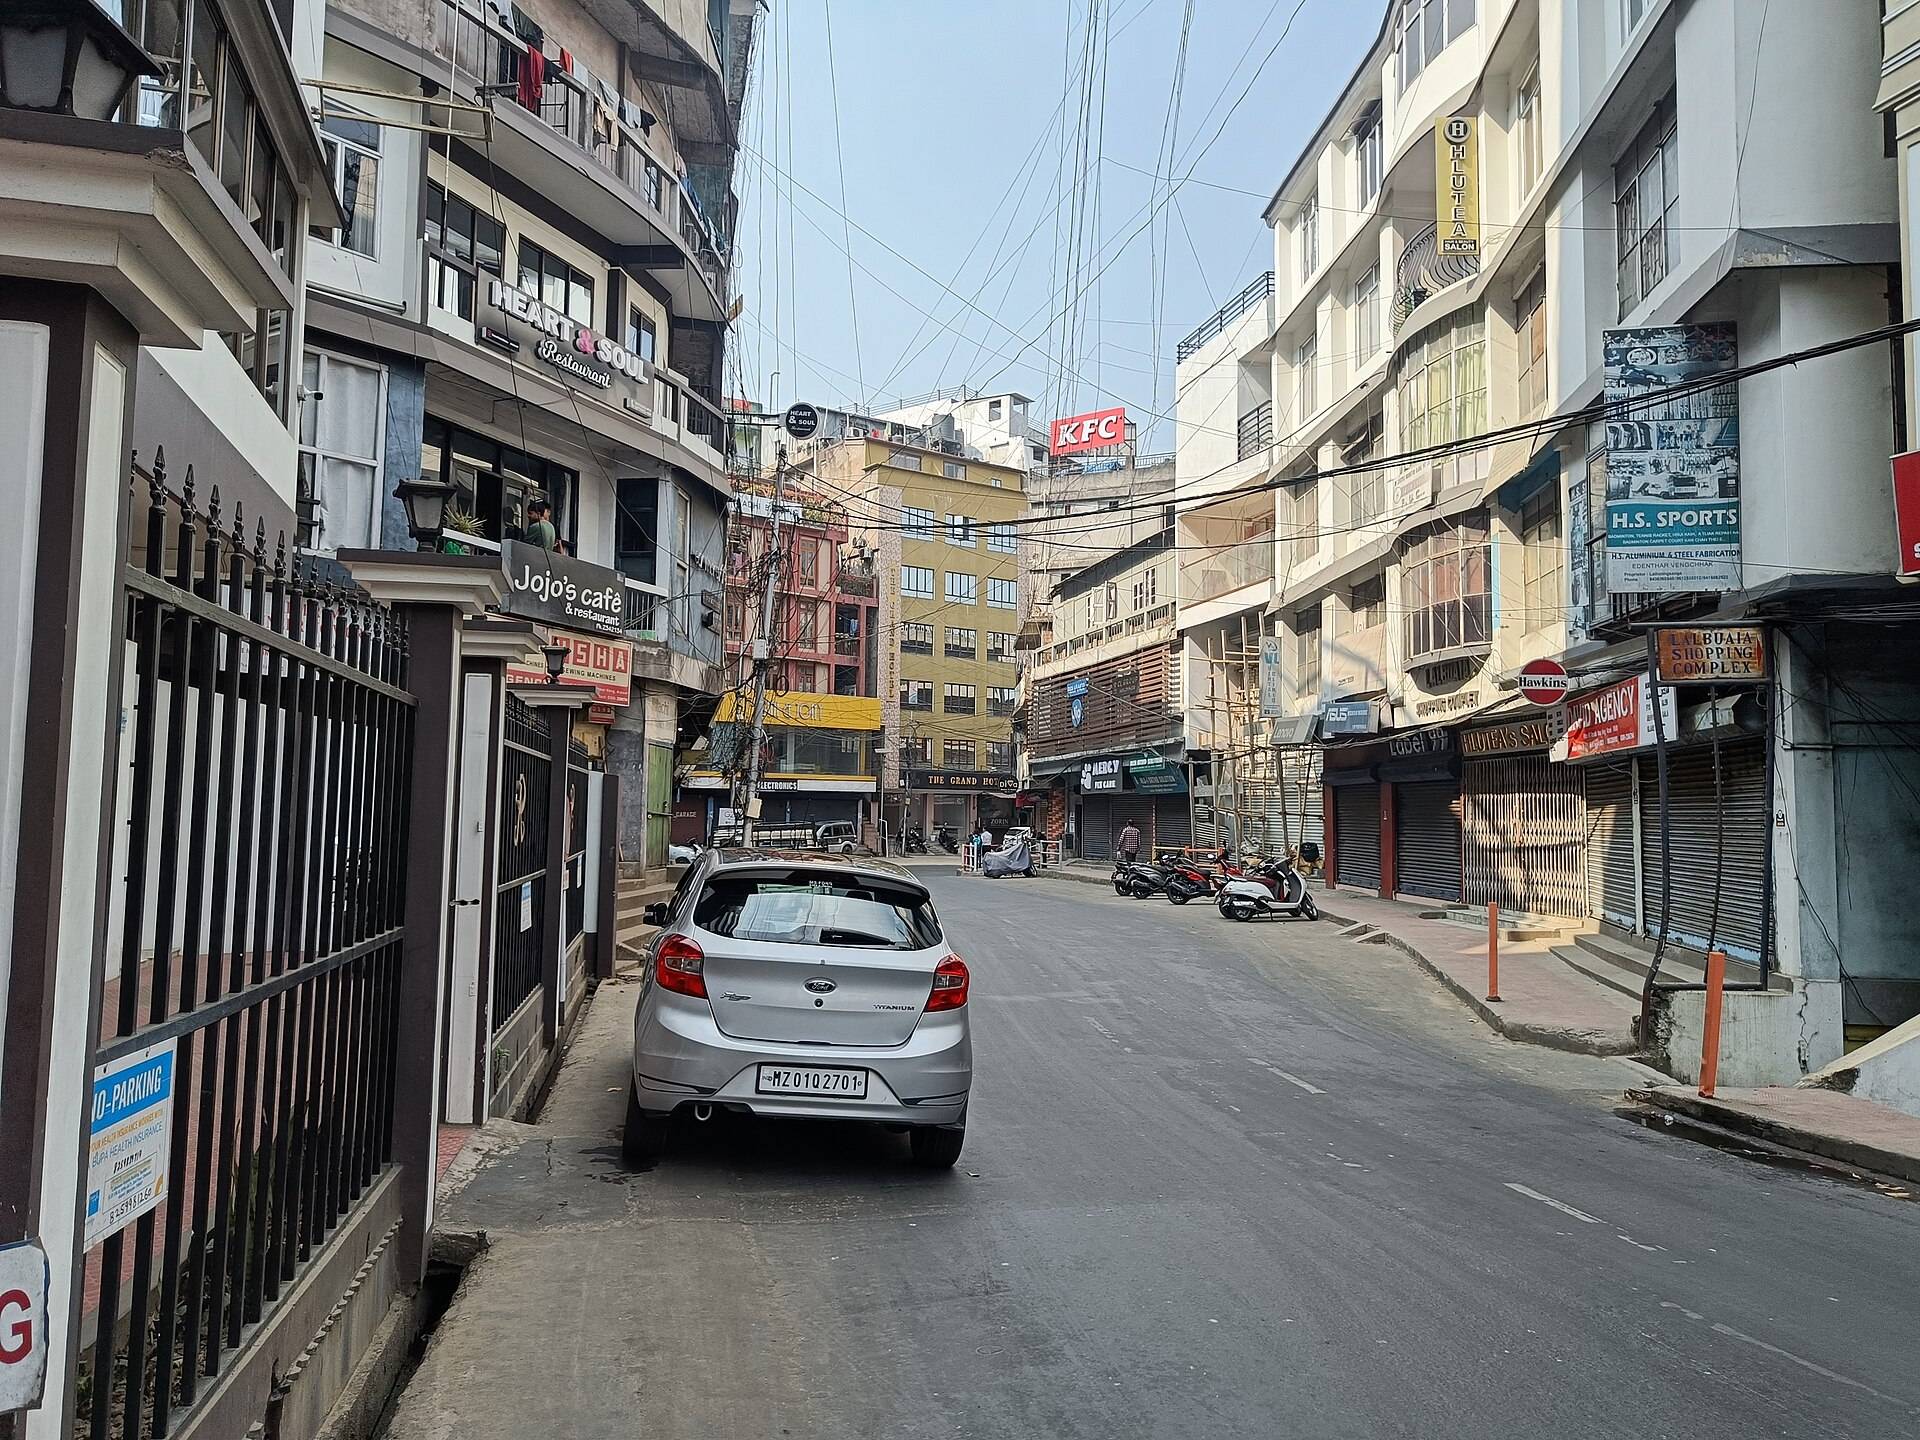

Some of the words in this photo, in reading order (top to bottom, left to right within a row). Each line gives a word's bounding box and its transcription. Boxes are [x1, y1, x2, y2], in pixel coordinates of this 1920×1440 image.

[1450, 144, 1467, 238] HLUTEA
[491, 280, 574, 342] HEART
[576, 328, 595, 354] &
[597, 339, 649, 385] SOUL
[541, 340, 611, 388] Restaurant
[1057, 414, 1118, 447] KFC
[1612, 512, 1651, 529] H.S.
[1657, 509, 1737, 527] SPORTS
[1625, 552, 1665, 560] ALUMINIUM
[1674, 551, 1694, 559] STEEL
[1695, 550, 1741, 558] FABRICATION
[514, 565, 577, 602] Jojo's
[565, 602, 573, 615] &
[574, 607, 620, 627] restaurant
[1671, 632, 1753, 646] LALBUAIA
[1672, 647, 1753, 660] SHOPPING
[587, 670, 616, 682] MACHINES
[1673, 661, 1752, 675] COMPLEX
[1519, 676, 1567, 688] Hawkins
[1416, 697, 1447, 717] SHOPPING
[1591, 684, 1635, 725] AGENCY
[1390, 731, 1425, 756] Label
[1092, 760, 1119, 775] MERCY
[928, 776, 945, 784] THE
[950, 776, 977, 785] GRAND
[1103, 780, 1116, 788] CARE
[811, 981, 831, 991] Ford
[772, 1071, 858, 1091] MZ01Q2701
[109, 1137, 133, 1158] HEALTH
[133, 1120, 163, 1143] INSURANCE
